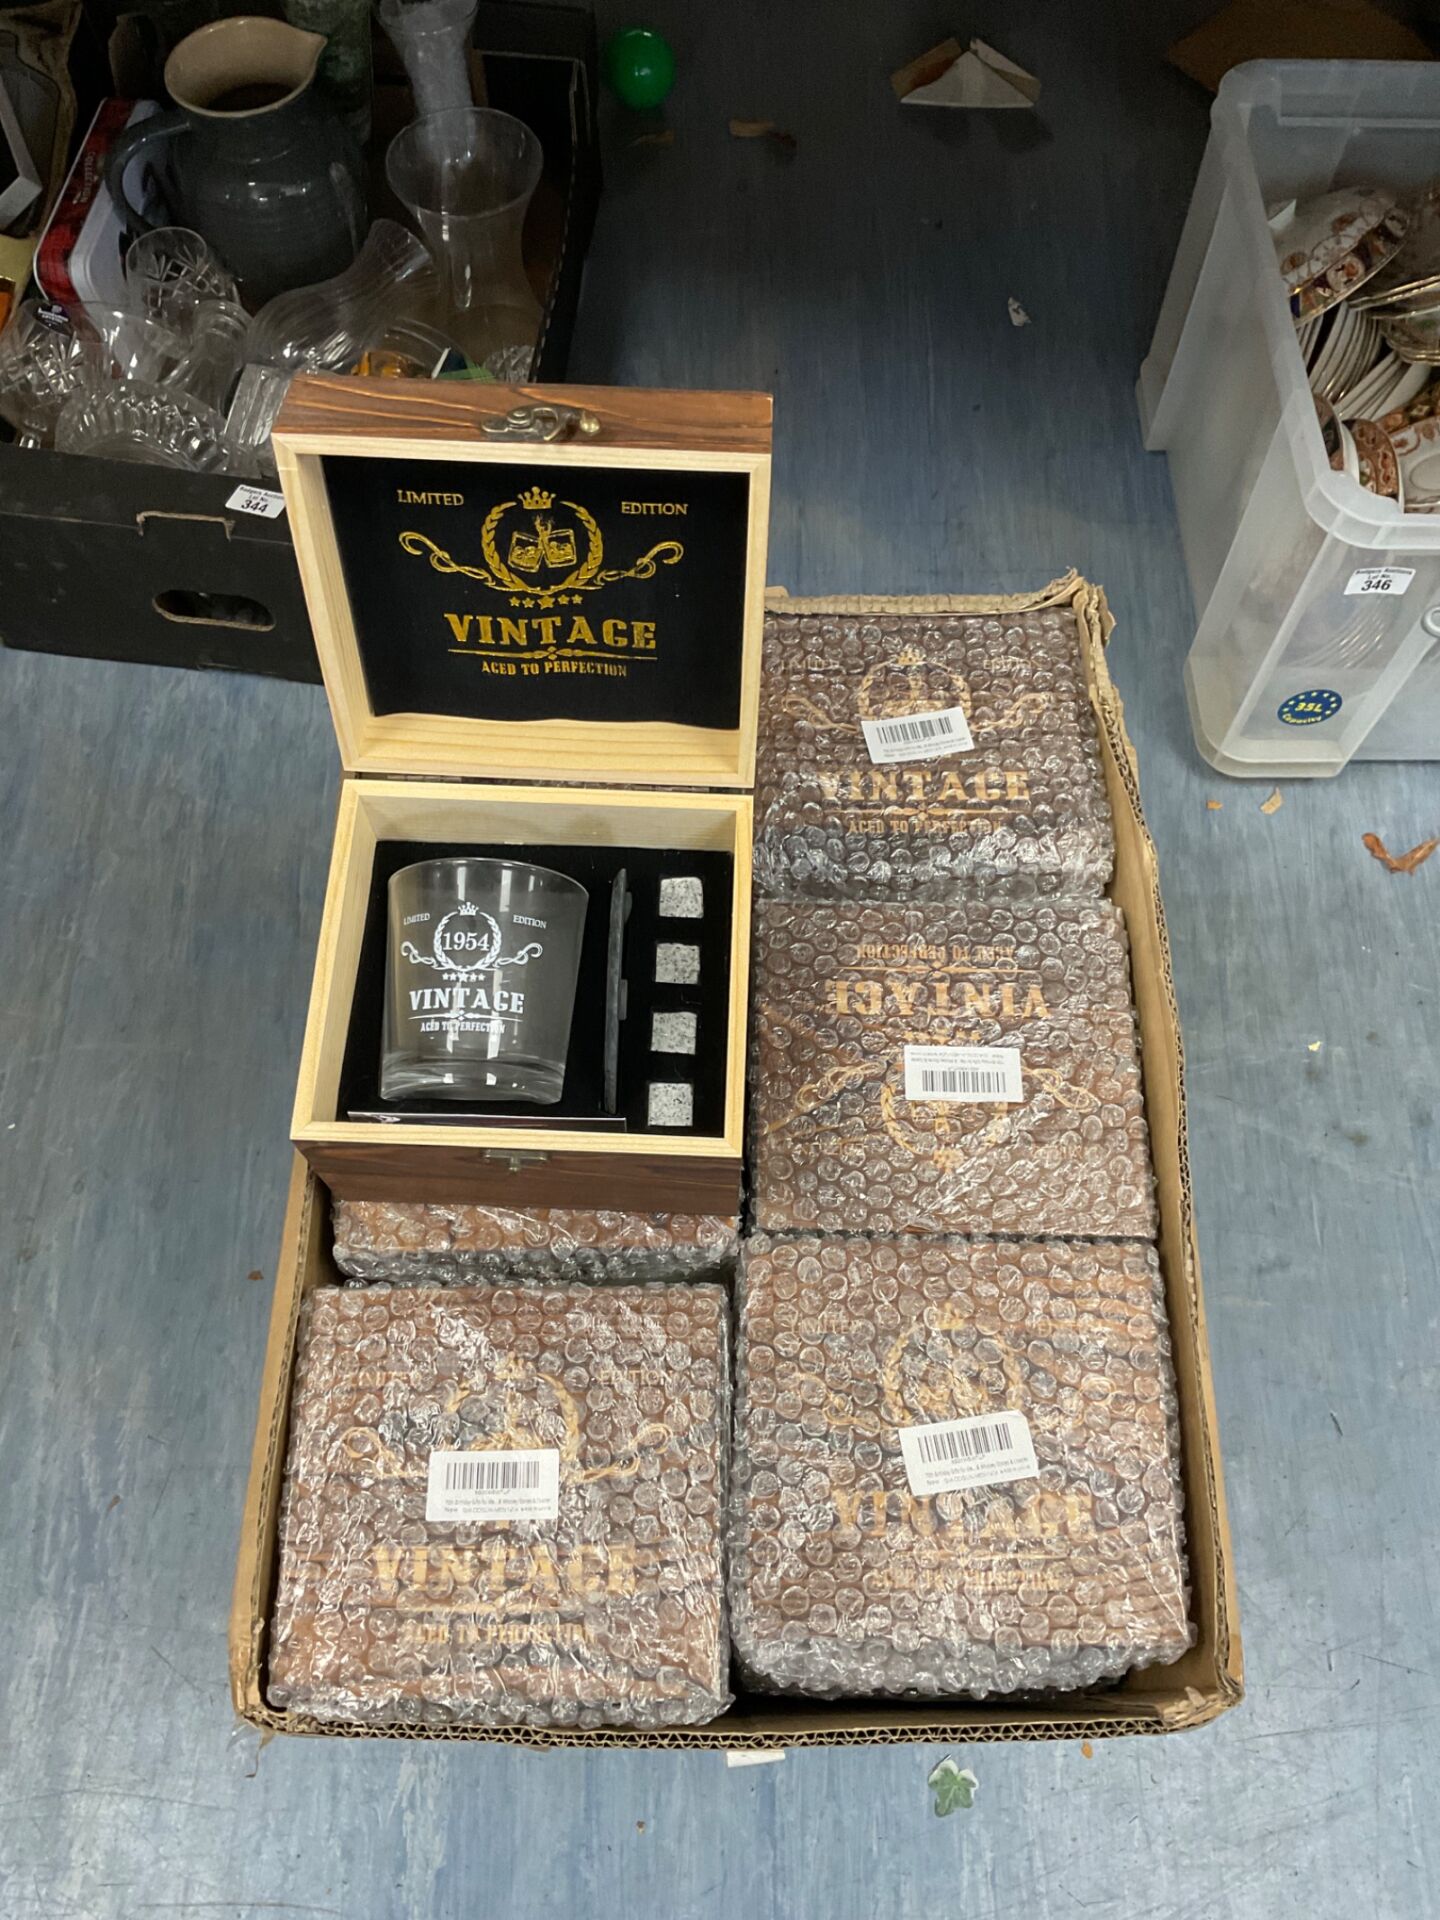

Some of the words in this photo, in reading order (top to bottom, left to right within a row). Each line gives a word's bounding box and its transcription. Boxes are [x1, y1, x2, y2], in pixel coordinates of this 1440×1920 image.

[397, 489, 464, 506] LIMITED
[241, 499, 268, 513] 344
[621, 501, 689, 516] EDITION
[1361, 580, 1392, 591] 346
[444, 612, 657, 650] VINTAGE
[521, 662, 540, 676] TO
[544, 660, 628, 678] PERFECTION
[403, 912, 430, 926] LIMITED
[513, 914, 547, 929] EDITION
[442, 931, 490, 951] 1954
[409, 987, 525, 1014] VINTAGE
